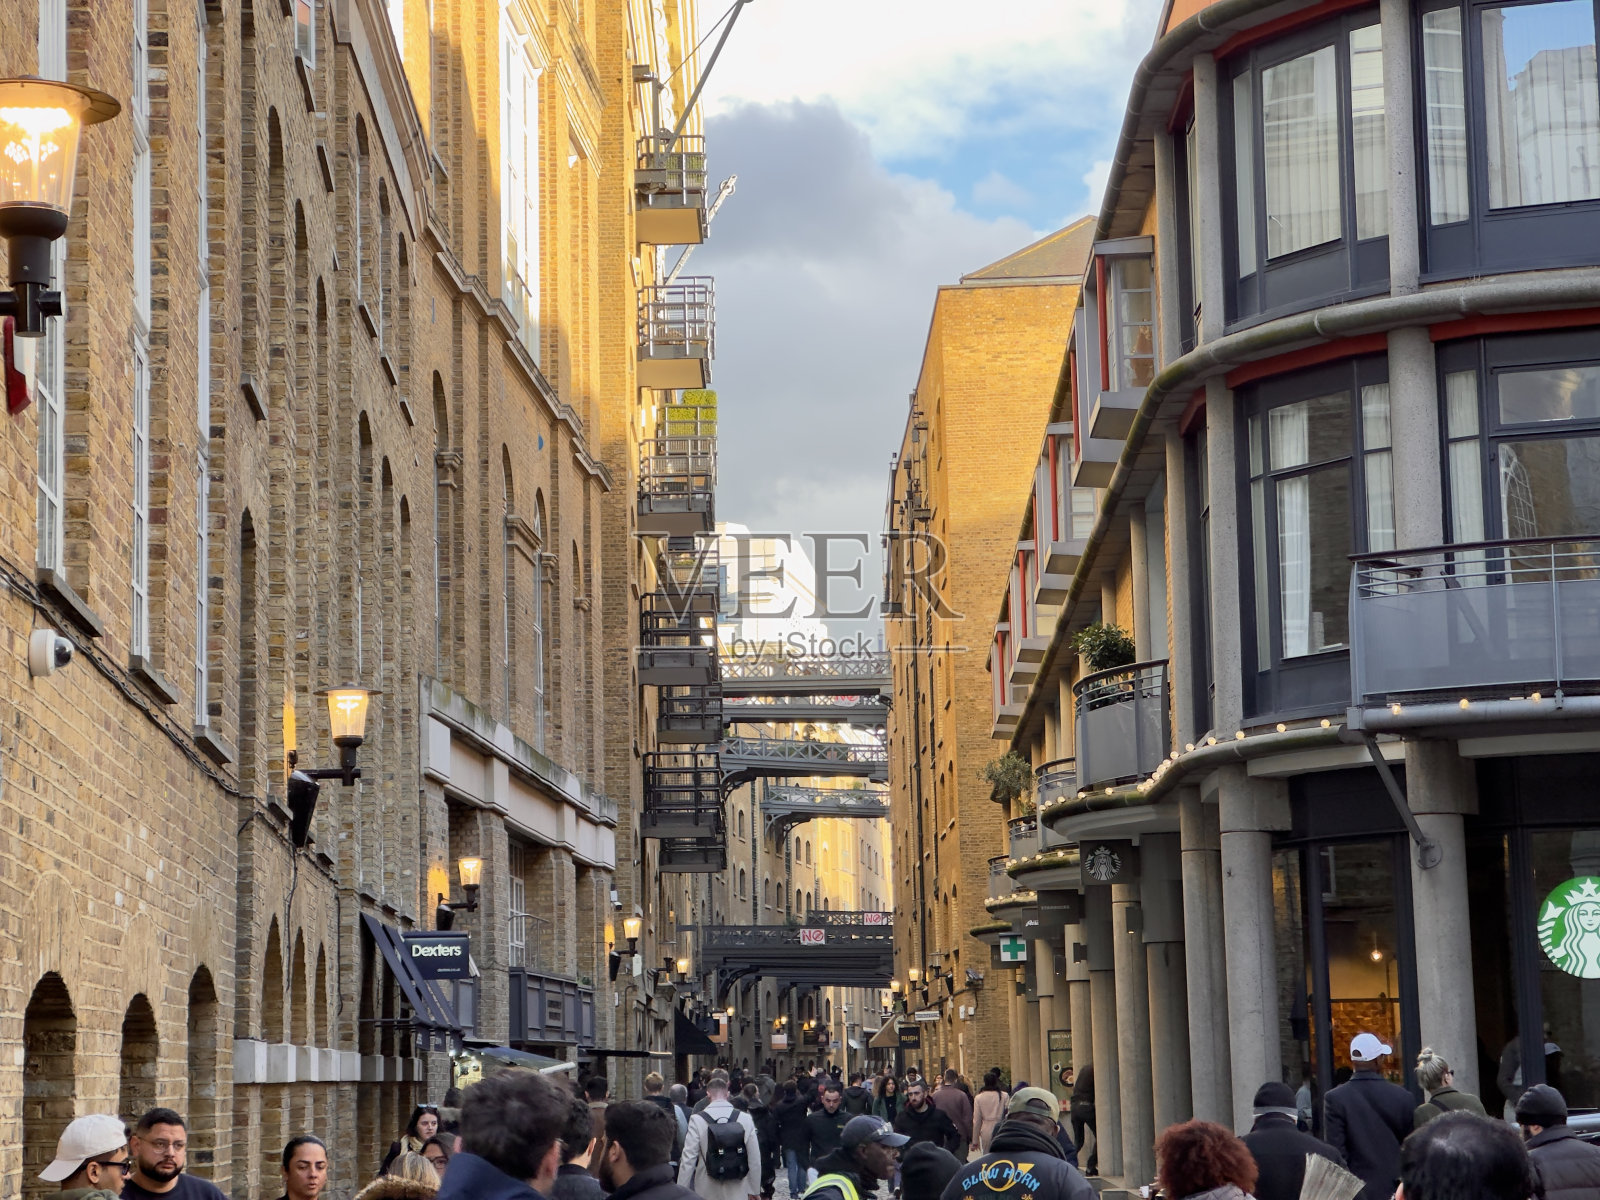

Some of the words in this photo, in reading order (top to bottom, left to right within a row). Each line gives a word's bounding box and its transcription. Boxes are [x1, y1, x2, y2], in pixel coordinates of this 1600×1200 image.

[865, 913, 882, 923] NO
[801, 929, 824, 942] NO
[411, 944, 462, 957] Dexters
[962, 1168, 999, 1191] BLOW
[1003, 1168, 1041, 1192] HORN
